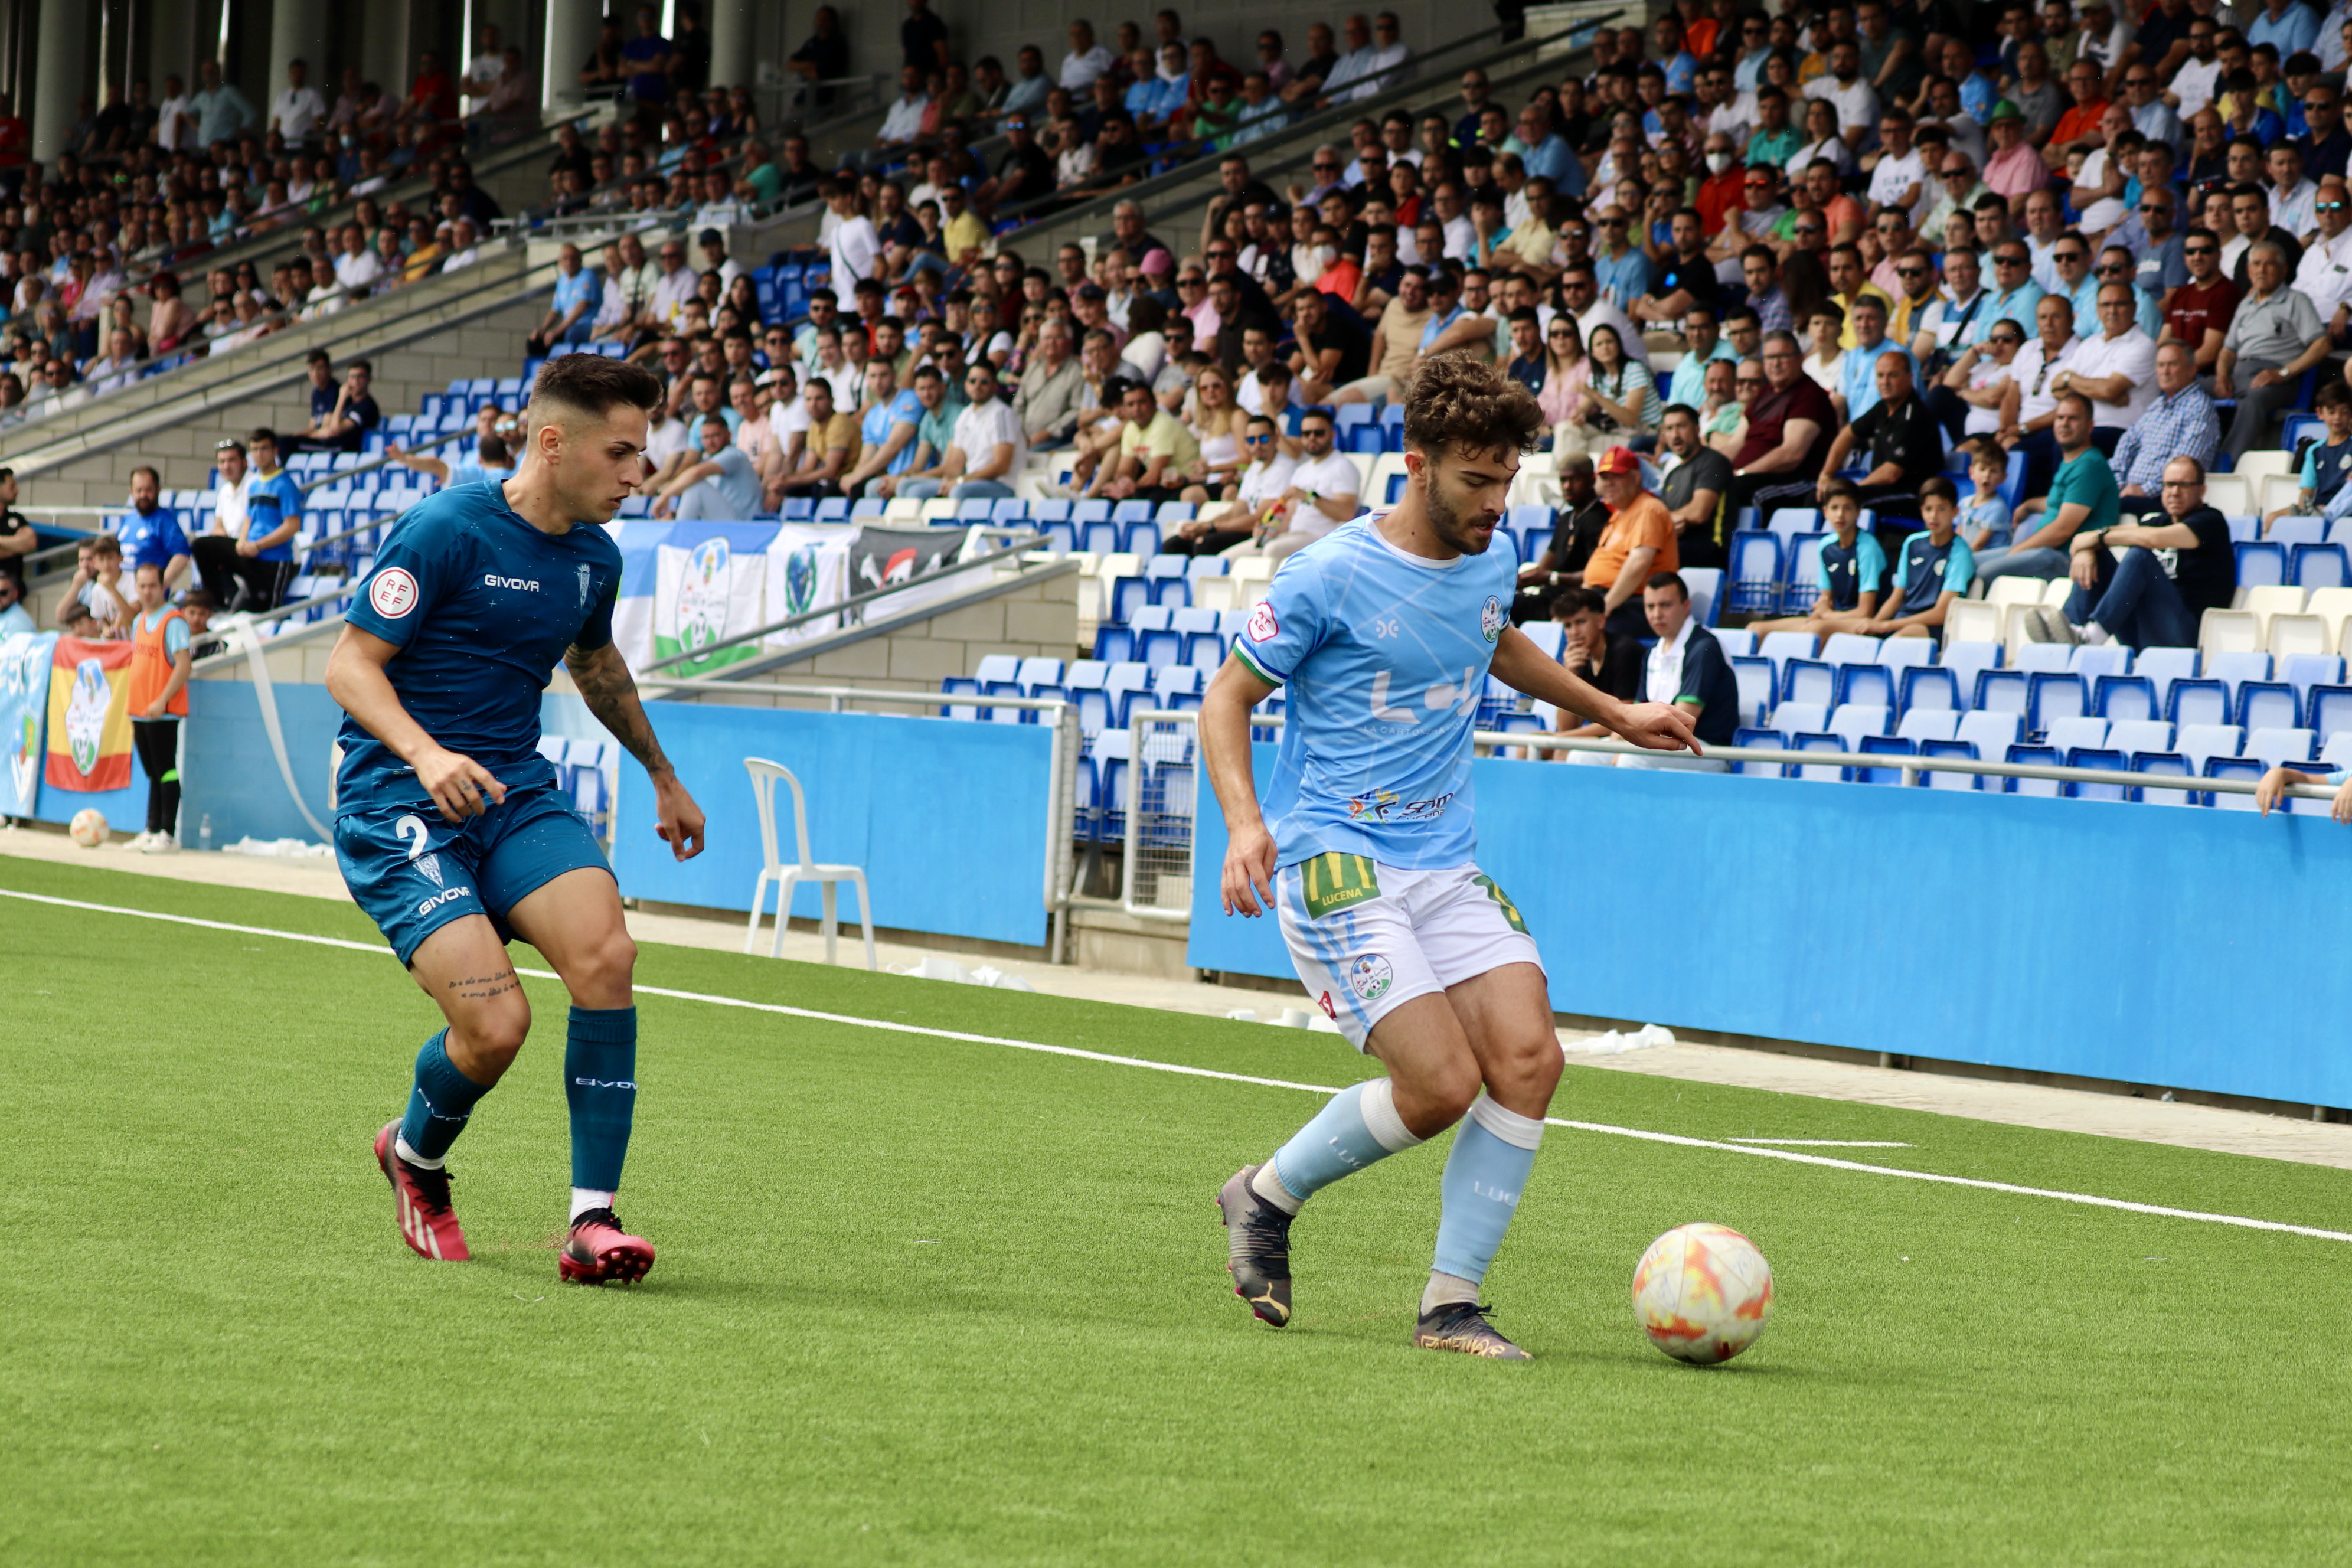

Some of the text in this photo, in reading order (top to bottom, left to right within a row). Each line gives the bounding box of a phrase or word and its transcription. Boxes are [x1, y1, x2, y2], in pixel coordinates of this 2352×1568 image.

[484, 574, 540, 592] GIVOVA
[396, 815, 428, 861] 2
[418, 886, 471, 916] GIVOVA
[1322, 888, 1363, 906] LUCENA
